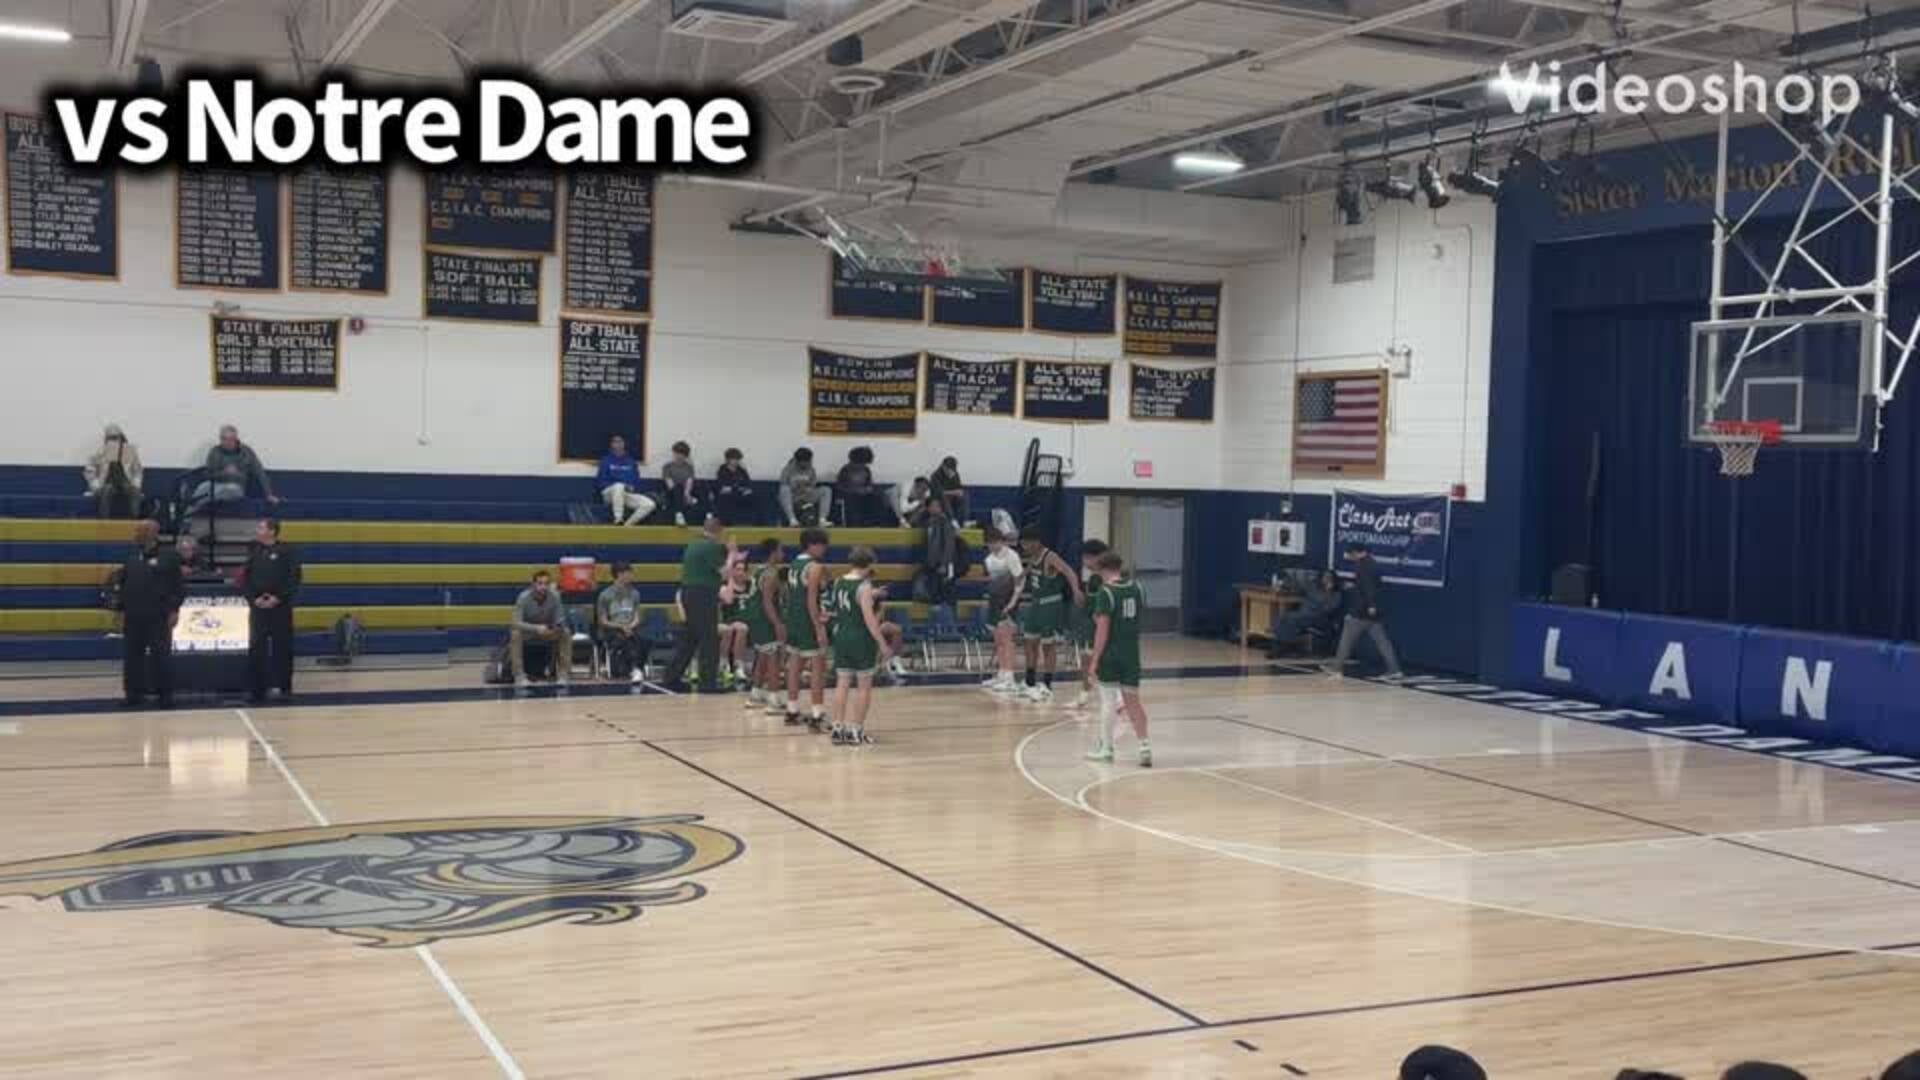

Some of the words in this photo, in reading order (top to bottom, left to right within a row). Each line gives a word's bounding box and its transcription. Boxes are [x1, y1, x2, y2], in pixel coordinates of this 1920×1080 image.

[1557, 172, 1637, 217] Sister
[1664, 153, 1800, 204] Marion
[433, 256, 471, 270] STATE
[434, 271, 529, 287] SOFTBALL
[1040, 275, 1107, 289] ALL-STATE
[1040, 287, 1105, 300] VOLLEYBALL
[223, 321, 260, 334] STATE
[271, 323, 328, 335] FINALIST
[570, 321, 638, 339] SOFTBALL
[216, 333, 251, 347] GIRLS
[257, 335, 334, 349] BASKETBALL
[569, 337, 640, 353] ALL-STATE
[933, 359, 1011, 375] ALL-STATE
[1034, 364, 1102, 377] ALL-STATE
[1136, 367, 1210, 381] ALL-STATE
[947, 372, 998, 385] TRACK
[1033, 375, 1064, 386] GIRLS
[1069, 376, 1102, 387] TENNIS
[1156, 379, 1191, 389] GOLF
[1338, 502, 1375, 528] Class
[1375, 507, 1412, 532] Act
[1337, 530, 1410, 546] SPORTSMANSHIP
[1123, 598, 1136, 617] 10
